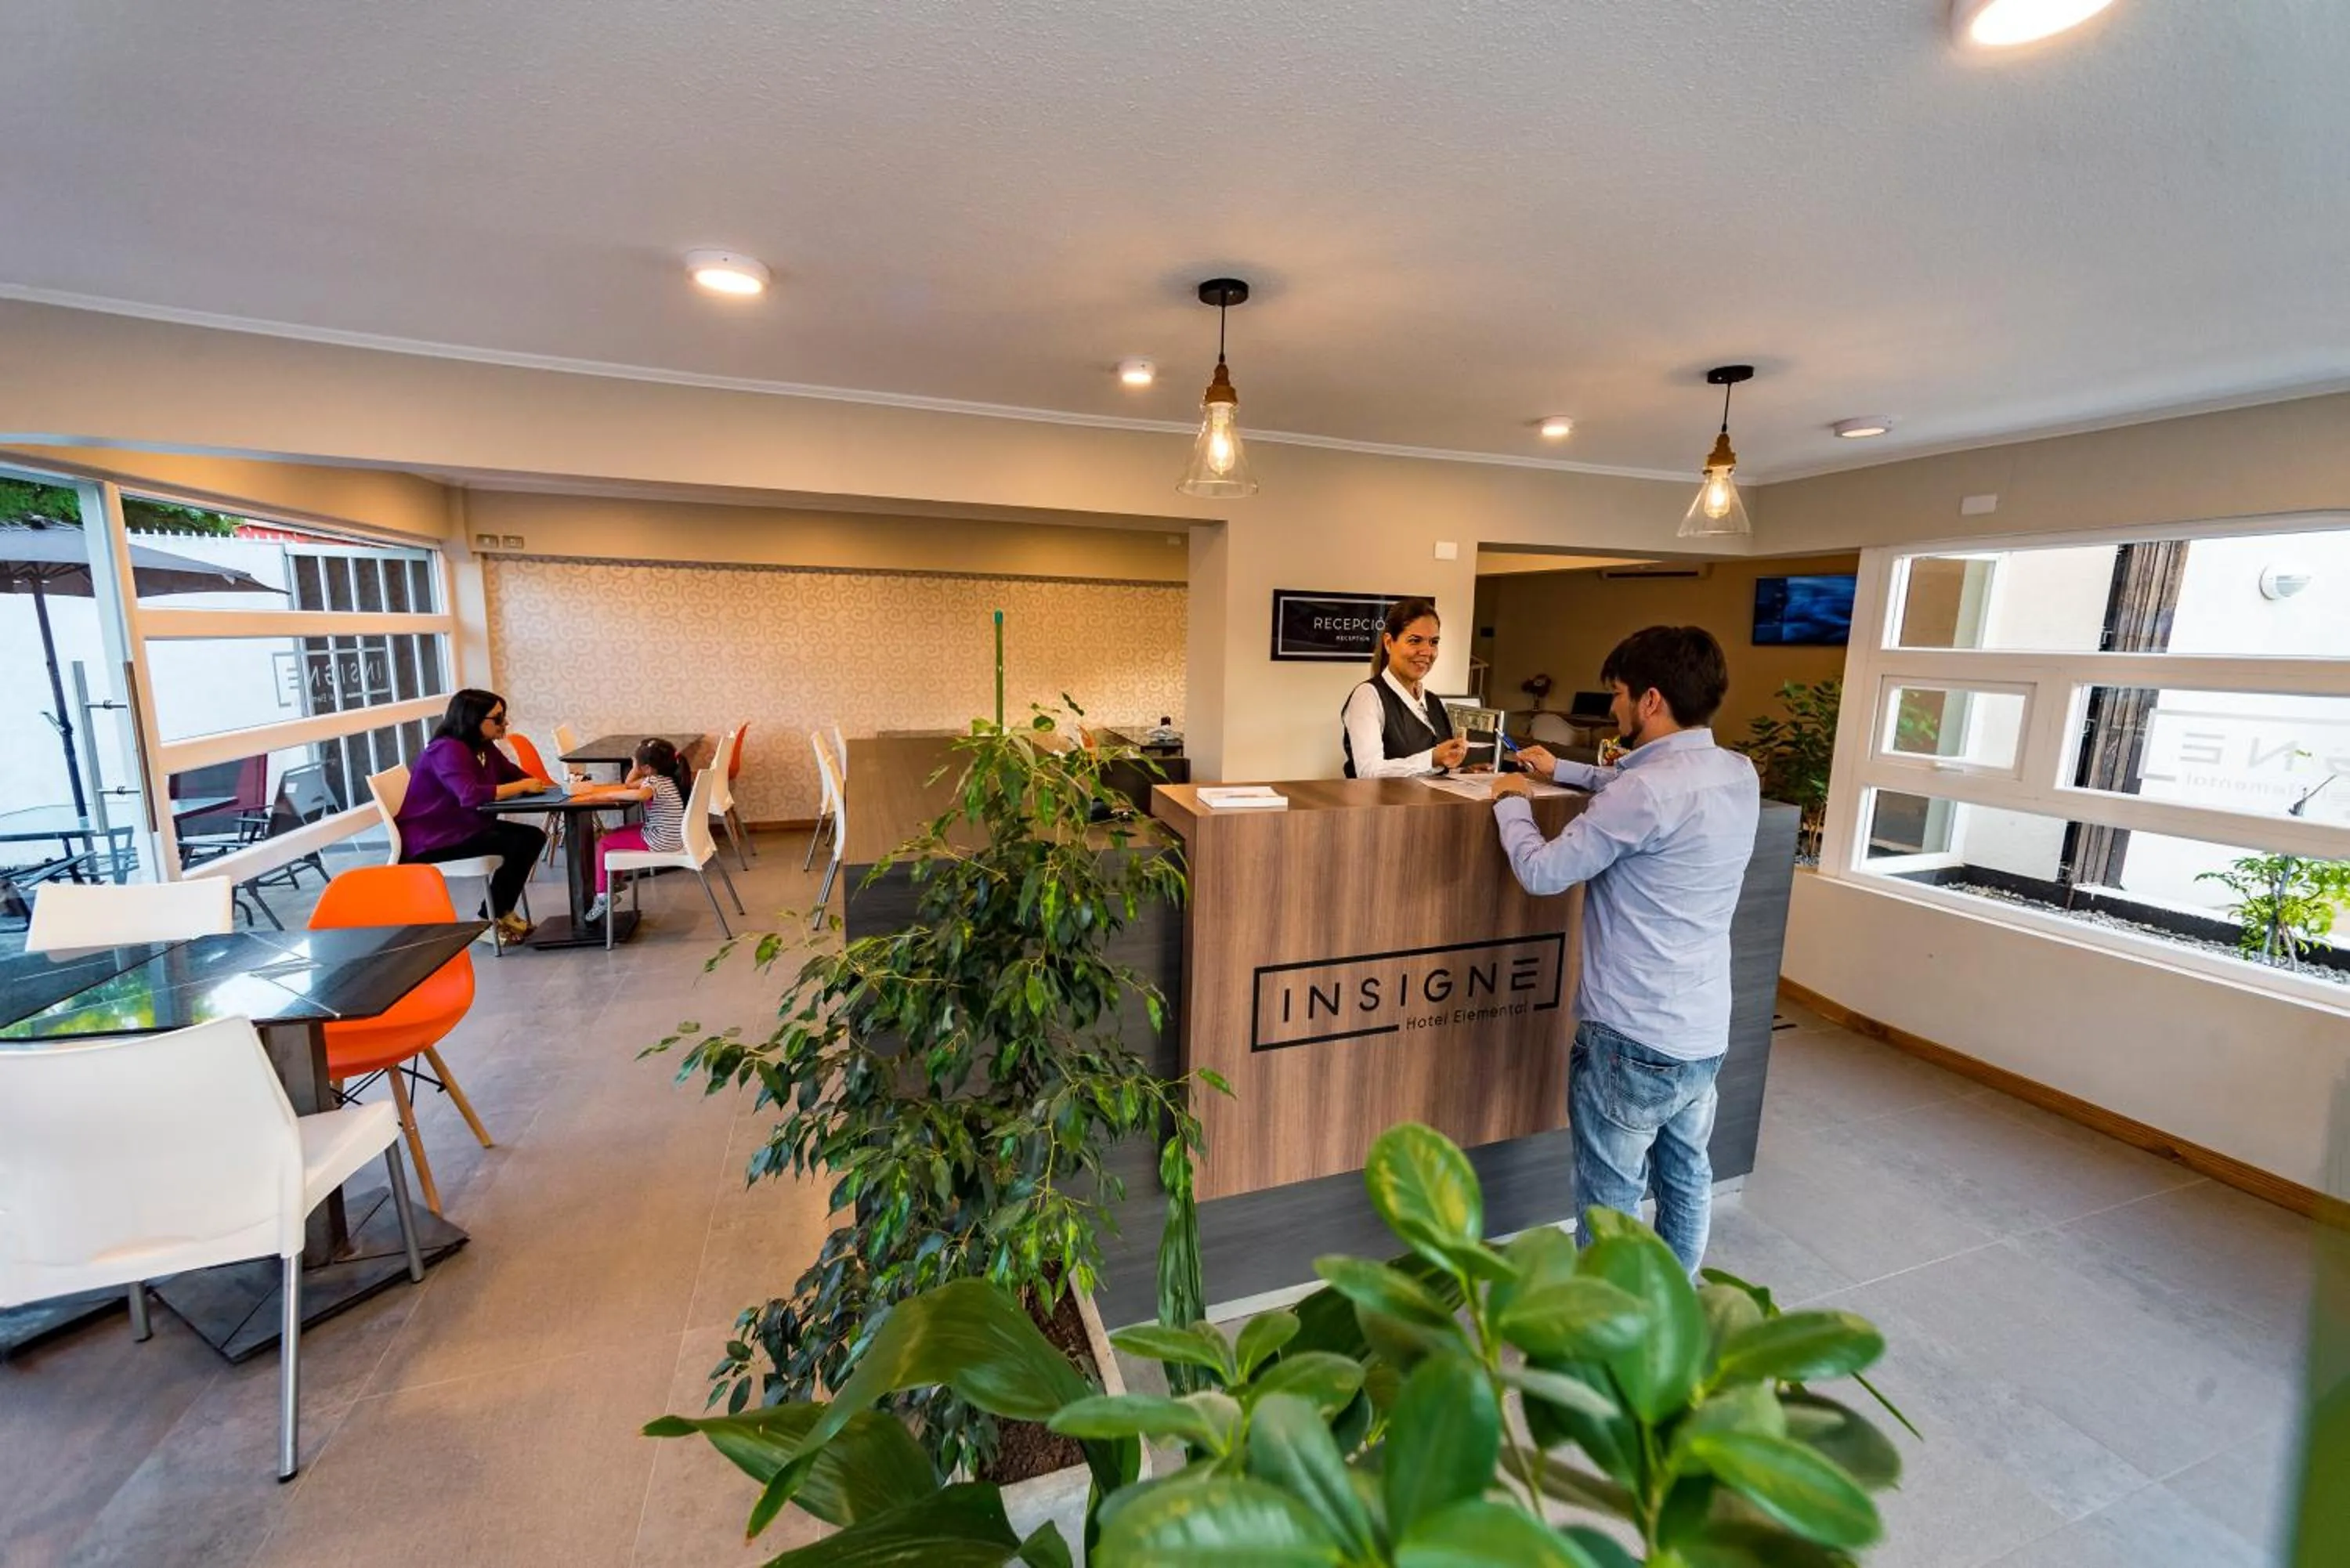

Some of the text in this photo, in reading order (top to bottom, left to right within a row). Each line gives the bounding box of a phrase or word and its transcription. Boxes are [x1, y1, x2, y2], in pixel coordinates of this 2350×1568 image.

[1314, 616, 1386, 631] RECEPCIÓ
[1283, 957, 1539, 1023] INSIGNE
[1406, 1001, 1528, 1030] Hotel Elemental
